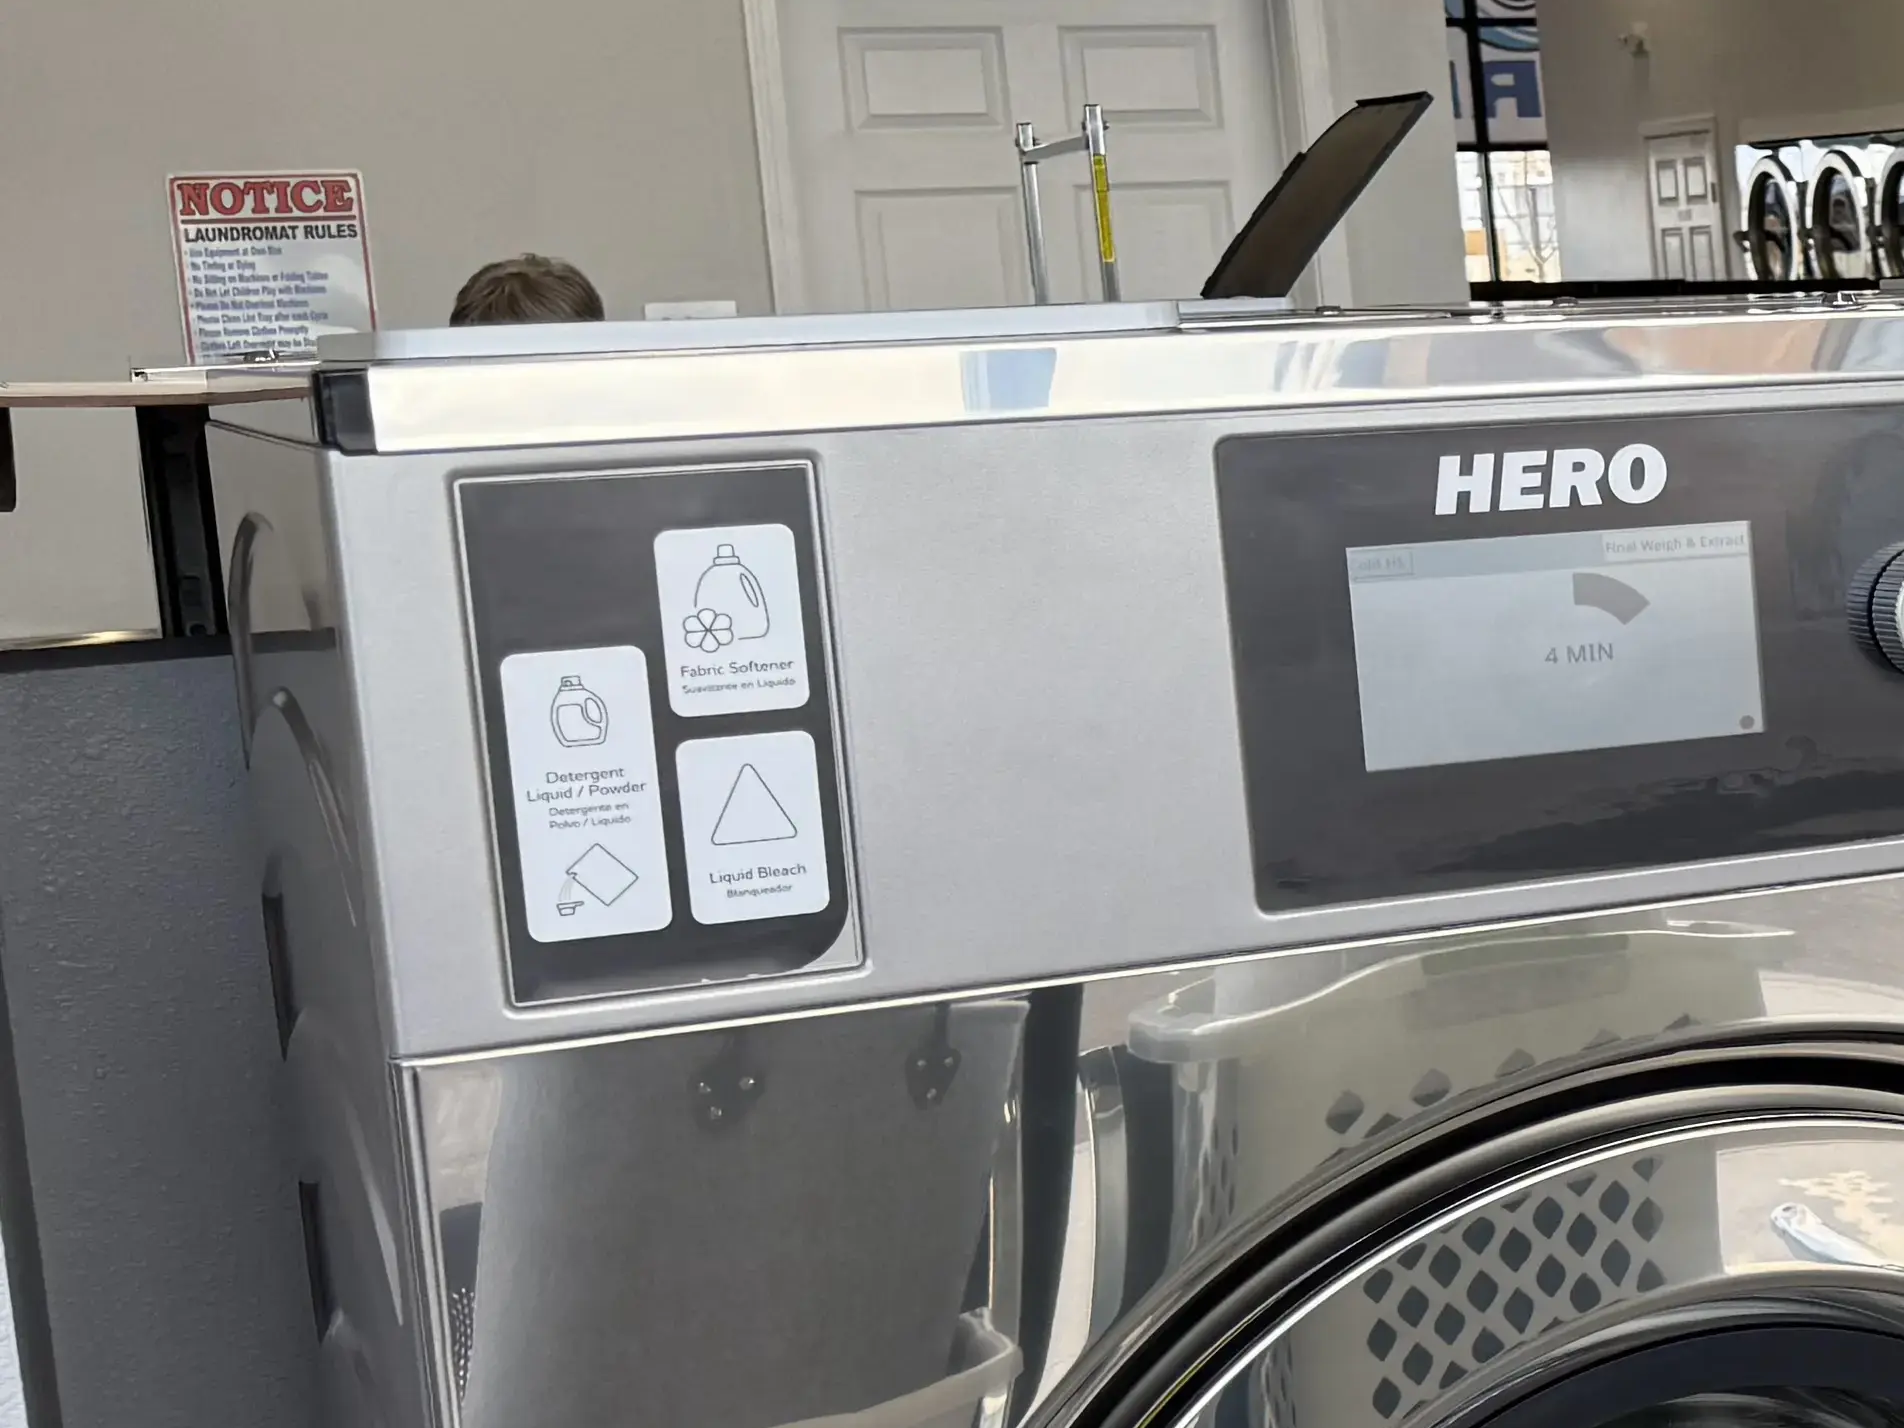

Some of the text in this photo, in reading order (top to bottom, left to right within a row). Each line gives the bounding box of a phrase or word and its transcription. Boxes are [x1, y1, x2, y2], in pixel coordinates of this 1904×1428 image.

[177, 180, 354, 216] NOTICE
[184, 224, 358, 243] LAUNDROMAT RULES
[1435, 443, 1668, 515] HERO
[1605, 537, 1638, 555] Final
[1641, 535, 1682, 556] Weigh
[1700, 532, 1745, 549] Extract
[1545, 642, 1614, 664] 4 MIN
[680, 660, 795, 678] Fabric Softener
[545, 767, 625, 783] Detergent
[526, 786, 572, 803] Liquid
[588, 781, 646, 797] Powder
[709, 863, 807, 885] Liquid Bleach
